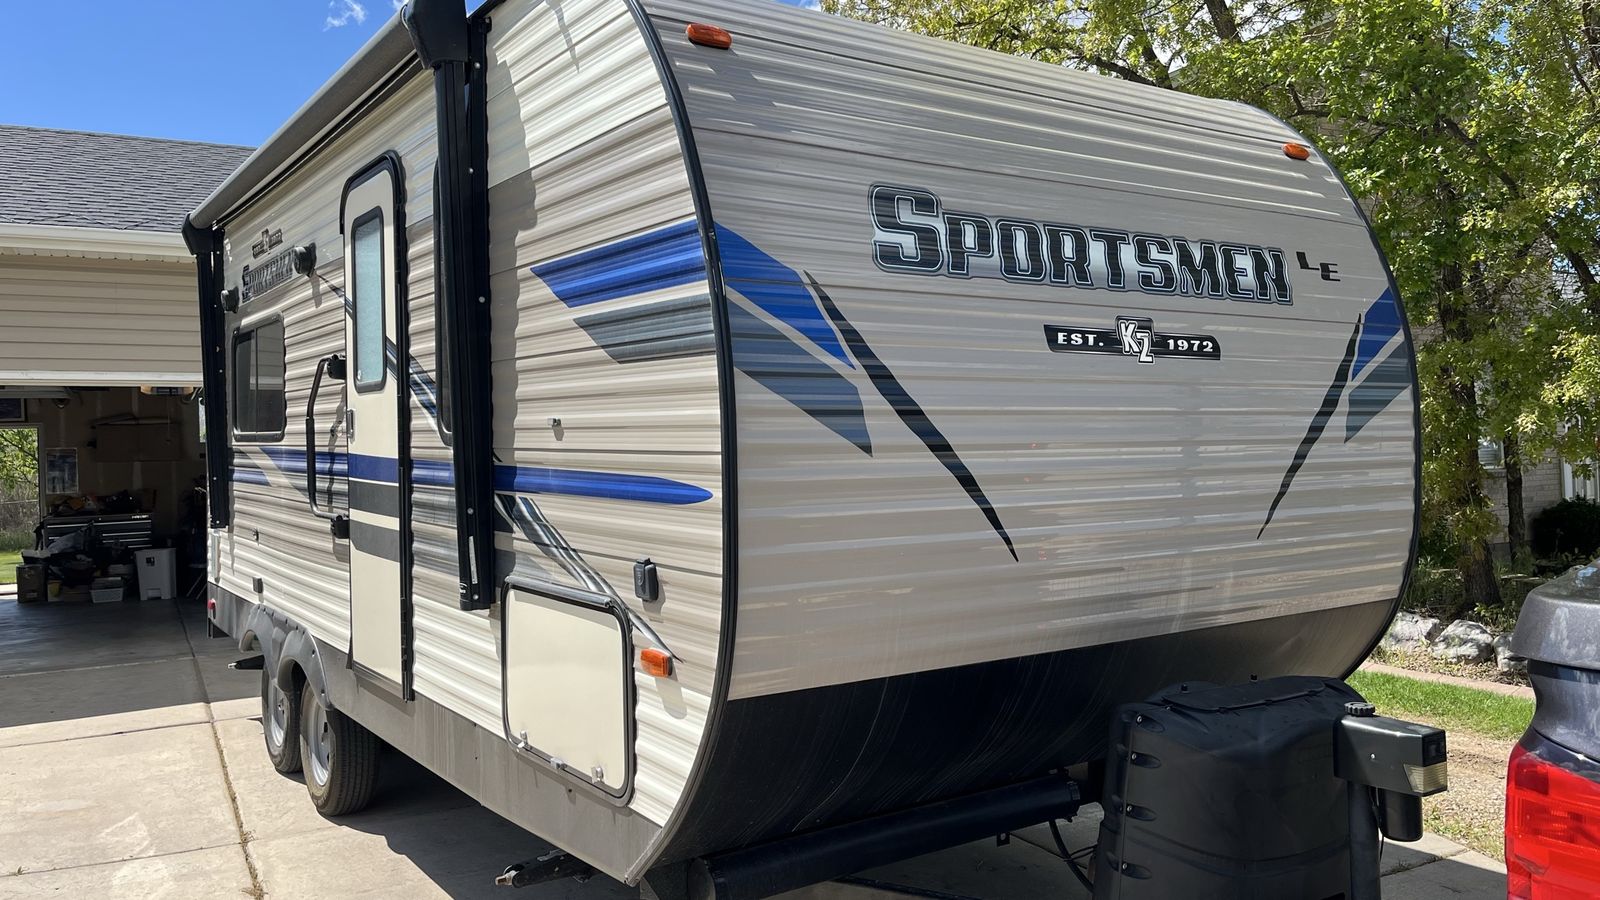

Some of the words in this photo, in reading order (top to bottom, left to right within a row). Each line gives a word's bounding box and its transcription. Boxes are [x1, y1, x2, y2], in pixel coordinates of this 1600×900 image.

[869, 184, 1292, 304] SPORTSMEN
[1295, 251, 1341, 281] LE
[1057, 332, 1104, 347] EST.
[1117, 319, 1154, 364] KZ
[1167, 338, 1213, 352] 1972
